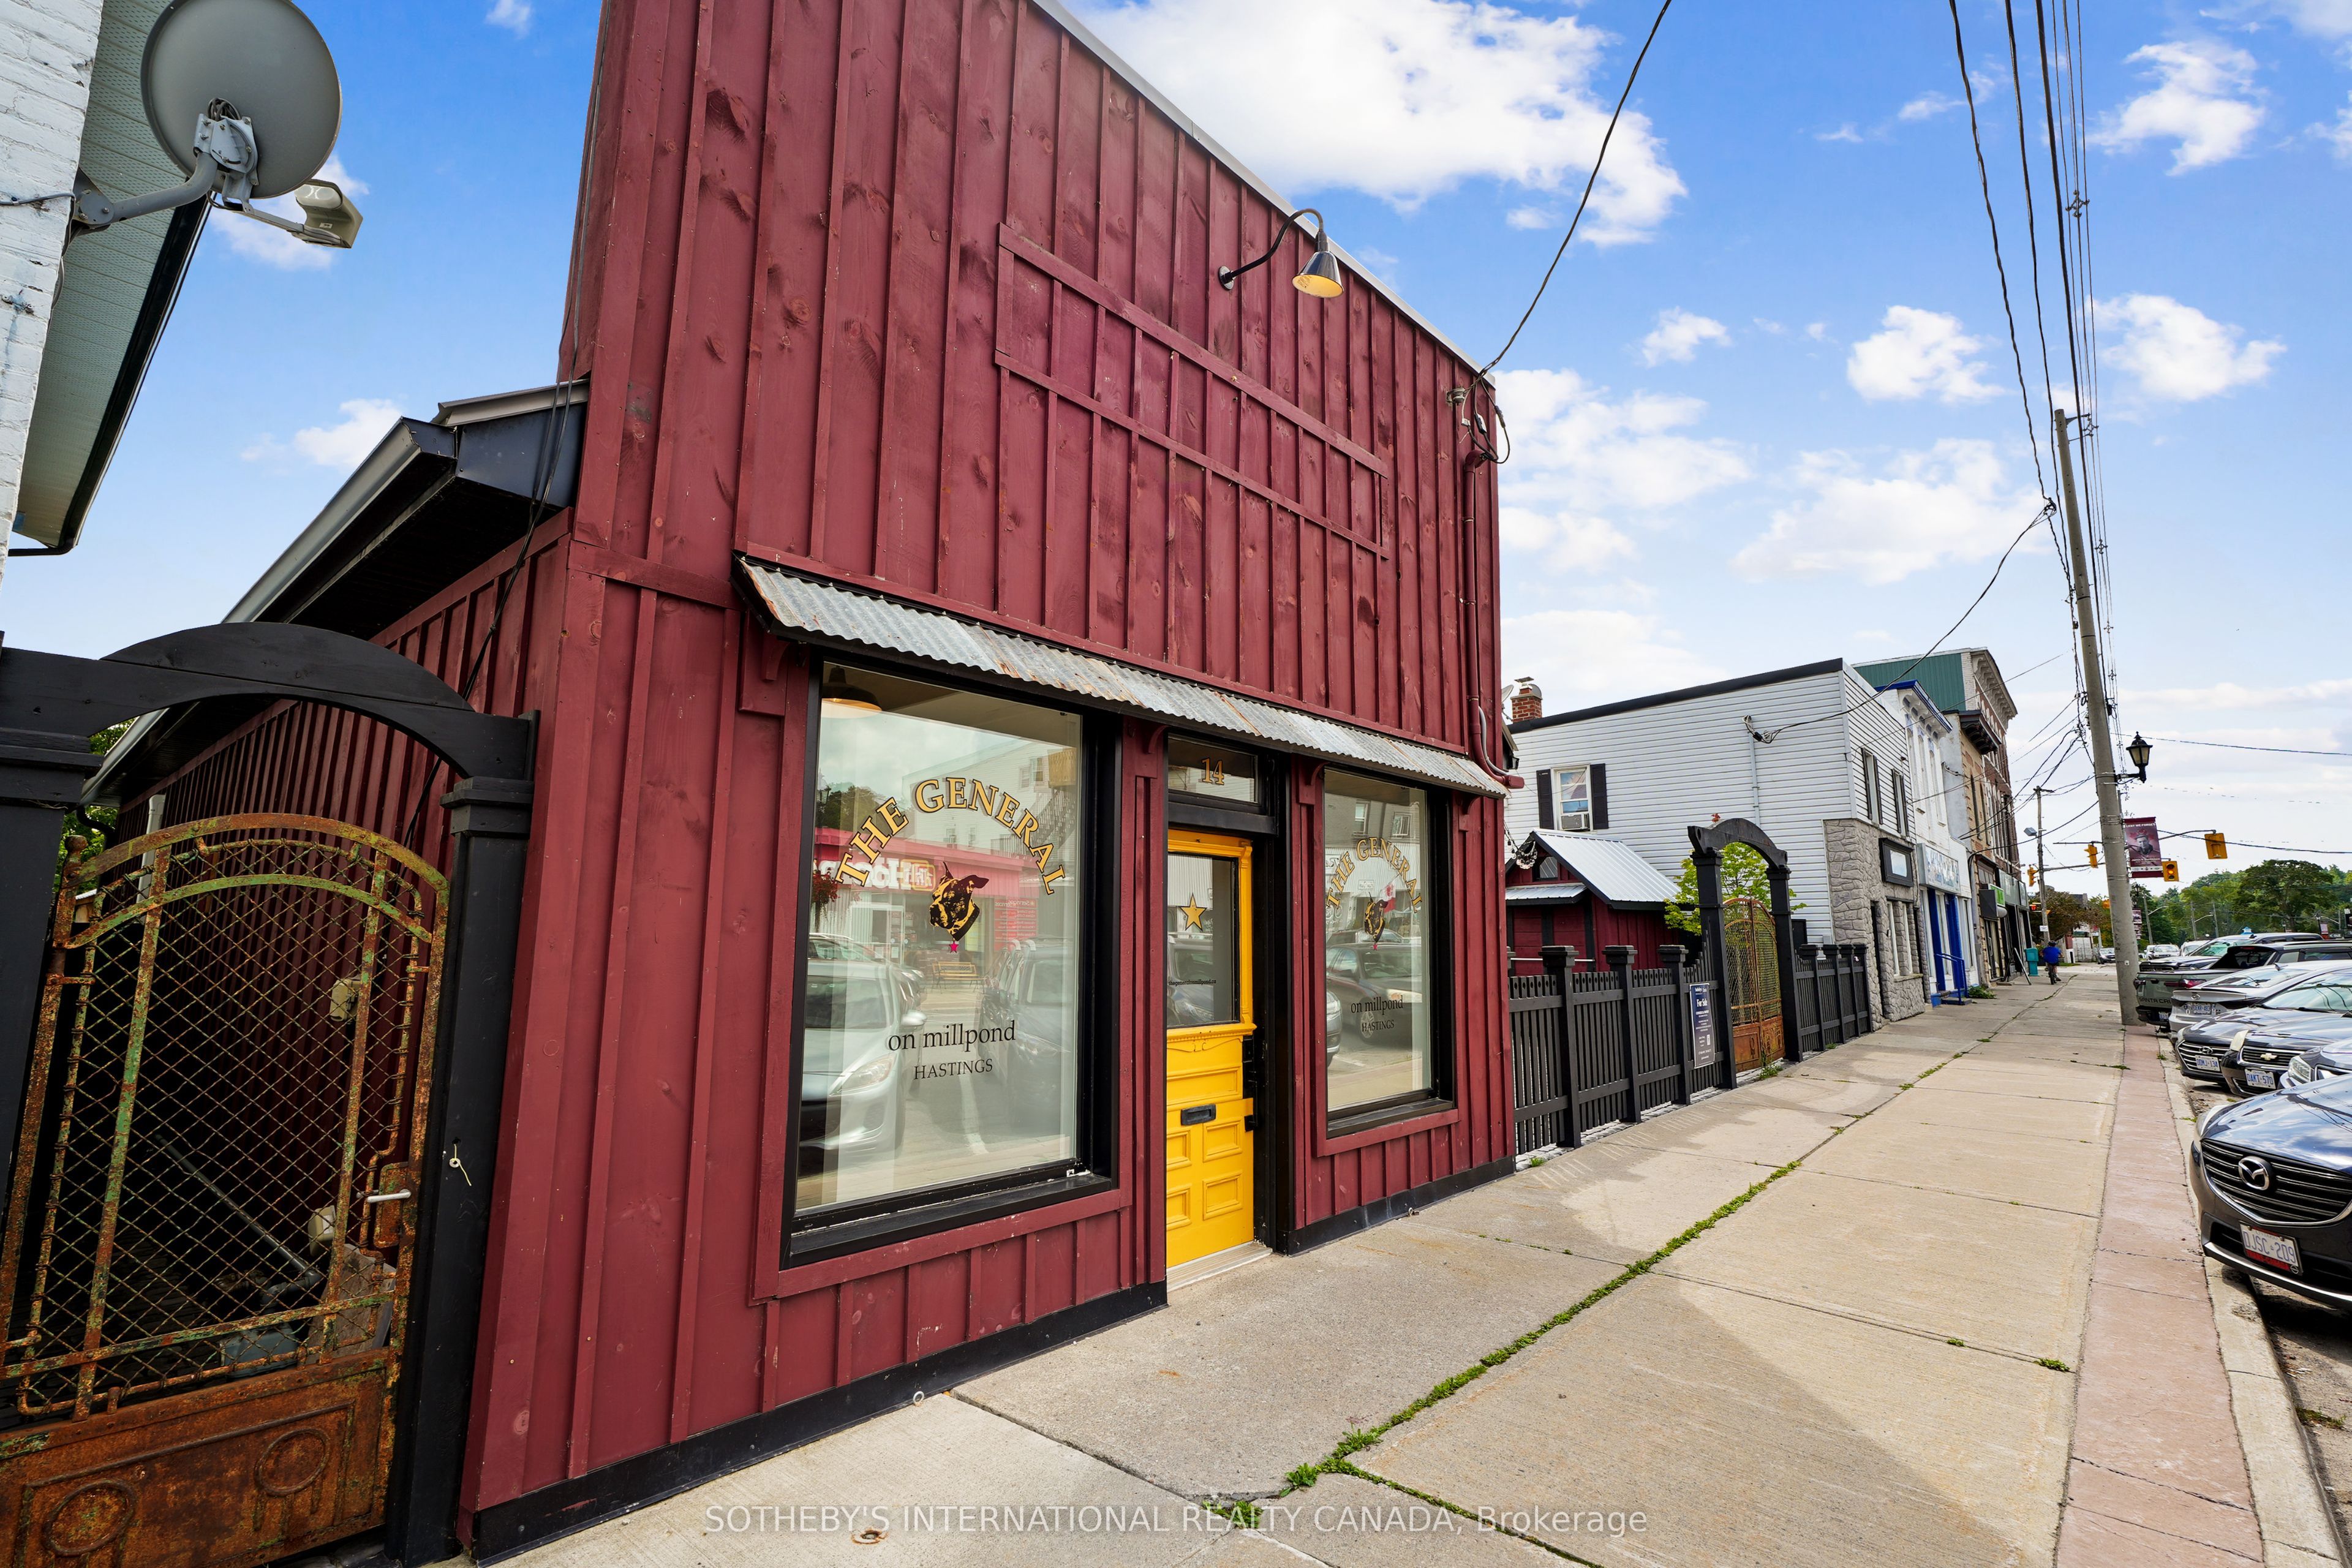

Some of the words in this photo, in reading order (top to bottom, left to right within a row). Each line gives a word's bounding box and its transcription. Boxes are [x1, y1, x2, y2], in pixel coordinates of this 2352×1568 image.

[1201, 757, 1224, 785] 14
[835, 797, 909, 887] THE
[915, 777, 1066, 895] GENERAL
[1326, 851, 1355, 910] THE
[1355, 837, 1422, 914] GENERAL
[1351, 1003, 1362, 1014] on
[1365, 995, 1403, 1016] millpond
[888, 1033, 916, 1051] on
[922, 1020, 1016, 1052] millpond
[1362, 1019, 1395, 1032] HASTINGS
[913, 1058, 993, 1080] HASTINGS
